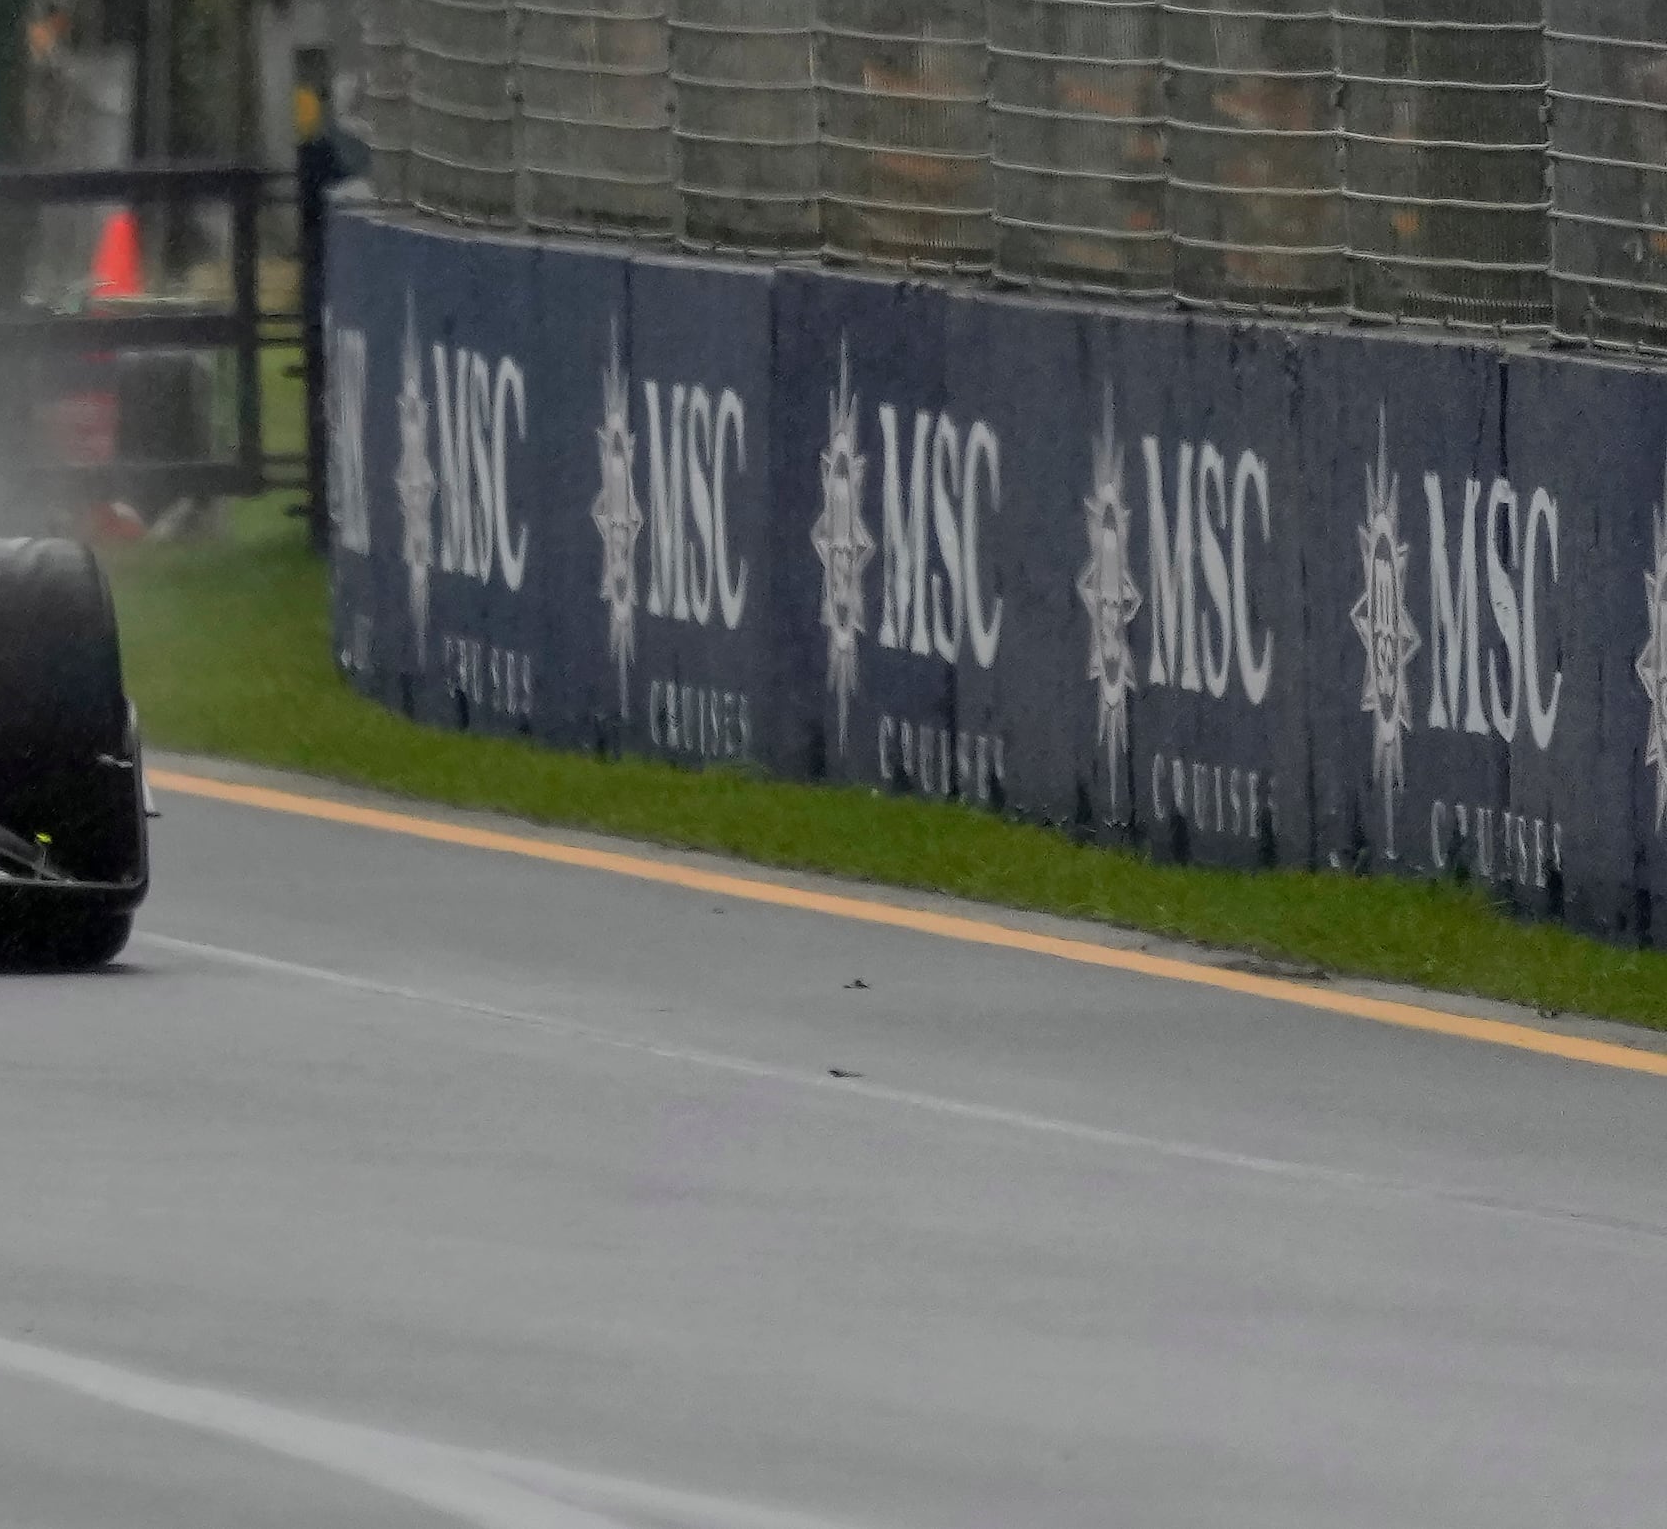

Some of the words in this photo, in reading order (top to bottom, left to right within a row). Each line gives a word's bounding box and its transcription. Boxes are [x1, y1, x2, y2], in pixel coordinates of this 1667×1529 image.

[432, 342, 528, 592] MSC
[644, 379, 749, 630] MSC
[878, 402, 1003, 669] MSC
[1142, 435, 1273, 705] MSC
[1424, 471, 1562, 750] MSC
